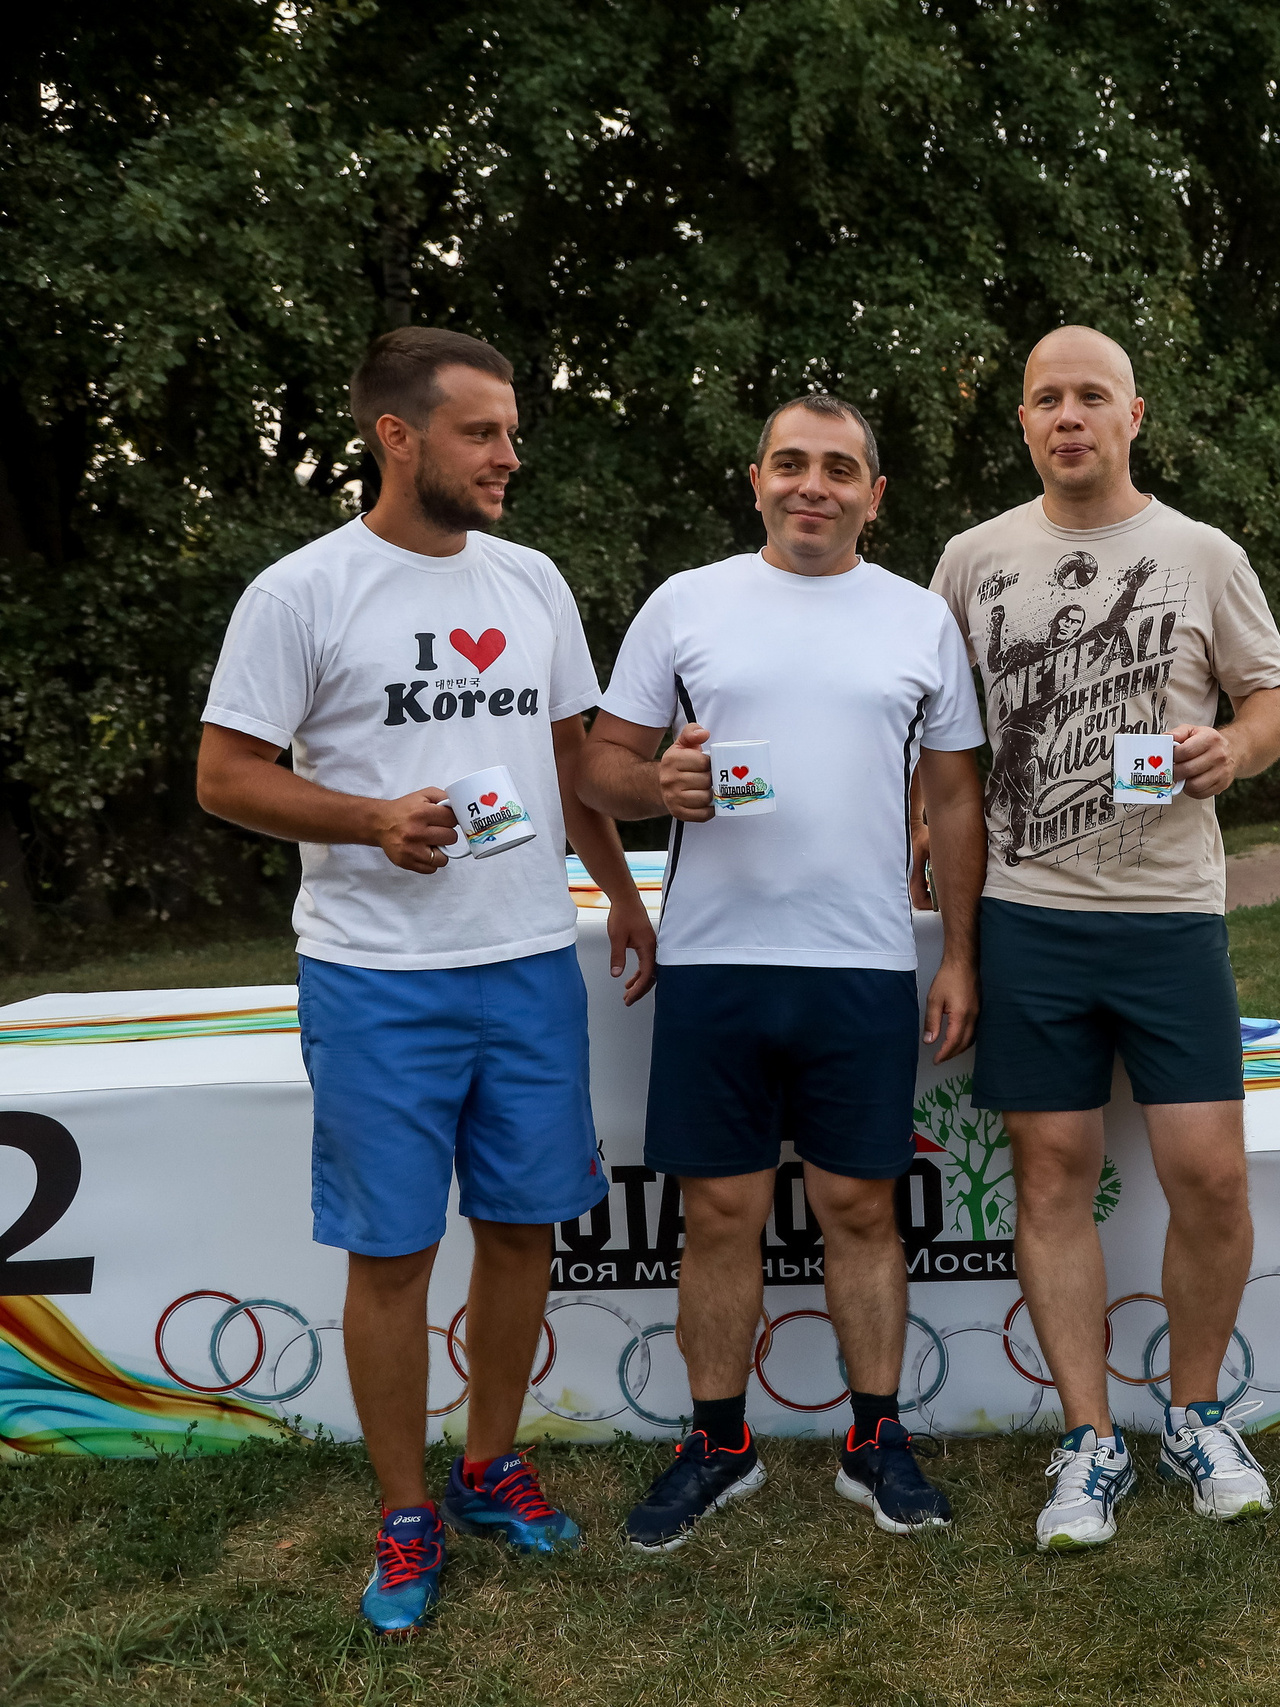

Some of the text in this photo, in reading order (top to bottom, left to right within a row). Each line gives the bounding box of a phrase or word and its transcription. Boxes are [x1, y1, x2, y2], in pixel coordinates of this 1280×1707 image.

[414, 632, 439, 671] I
[1100, 611, 1178, 676] ALL
[435, 677, 481, 690] 대한민국
[1055, 659, 1174, 726] DIFFERENT
[384, 680, 539, 726] Korea
[1084, 705, 1121, 737] BUT
[720, 769, 729, 783] Я
[1133, 758, 1144, 771] Я
[467, 802, 480, 818] Я
[1029, 793, 1115, 851] UNITES
[0, 1111, 95, 1297] 2
[907, 1248, 1017, 1274] Моск
